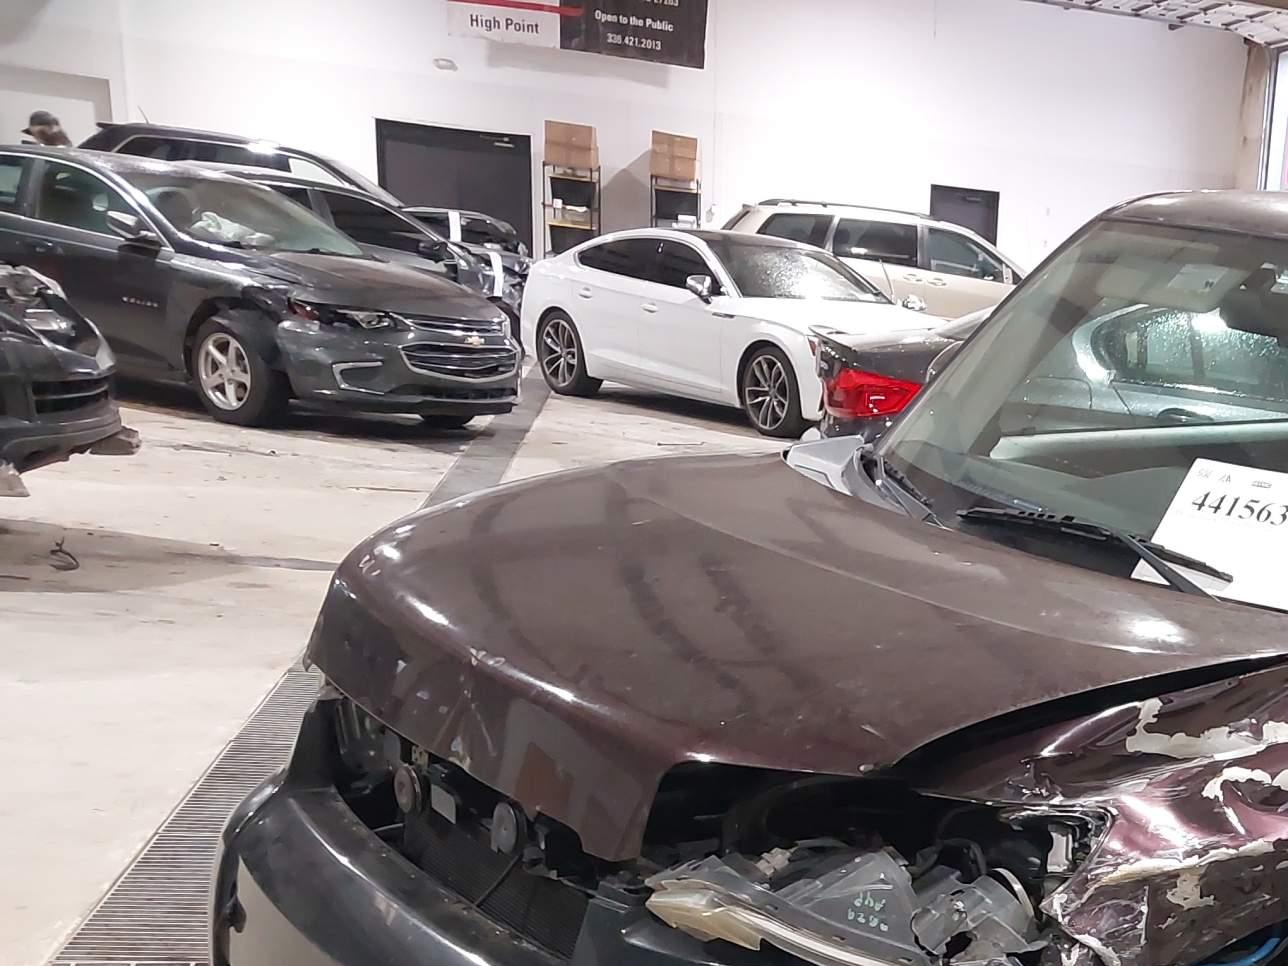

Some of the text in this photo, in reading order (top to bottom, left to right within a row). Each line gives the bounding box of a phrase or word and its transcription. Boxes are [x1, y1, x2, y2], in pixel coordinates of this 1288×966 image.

[470, 13, 539, 34] High Point
[594, 9, 674, 32] Open to the Public
